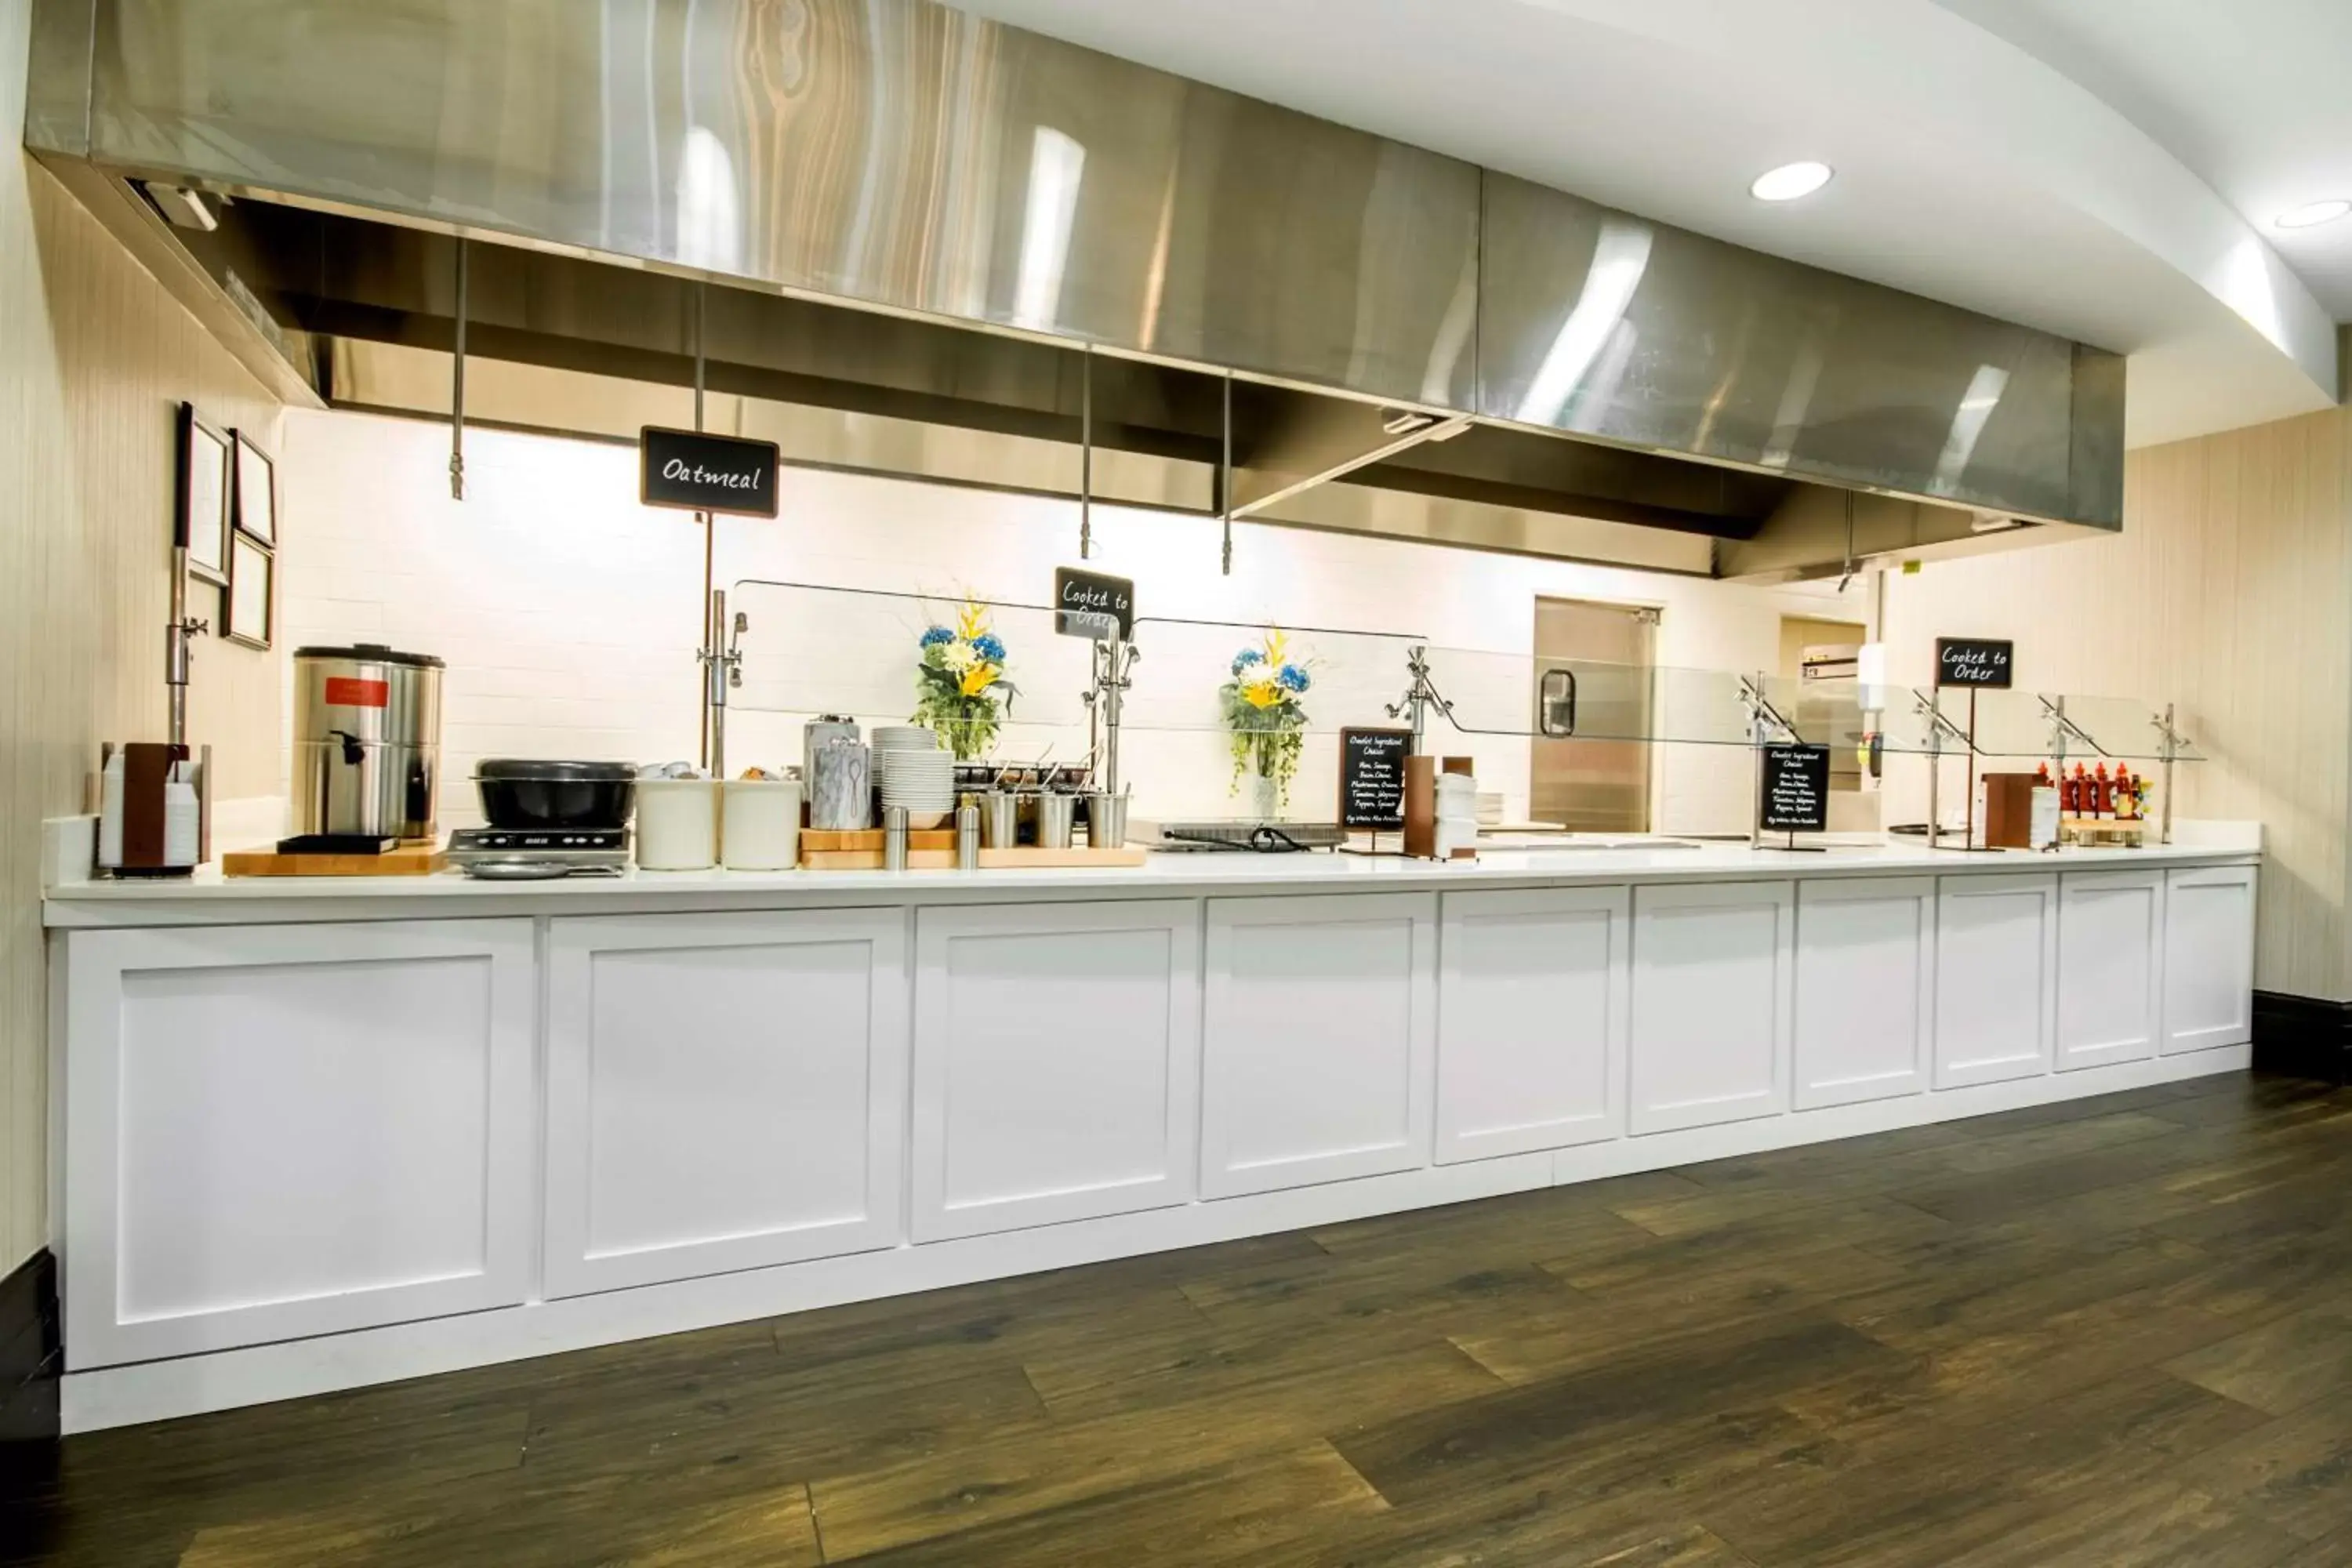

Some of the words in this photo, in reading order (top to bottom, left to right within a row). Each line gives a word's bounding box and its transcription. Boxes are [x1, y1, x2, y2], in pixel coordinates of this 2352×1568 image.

[662, 459, 761, 489] Oatmeal
[1062, 581, 1108, 607] Cooked
[1116, 593, 1127, 610] to
[1942, 647, 1987, 664] Cooked
[1994, 652, 2007, 665] to
[1955, 664, 1994, 680] Order
